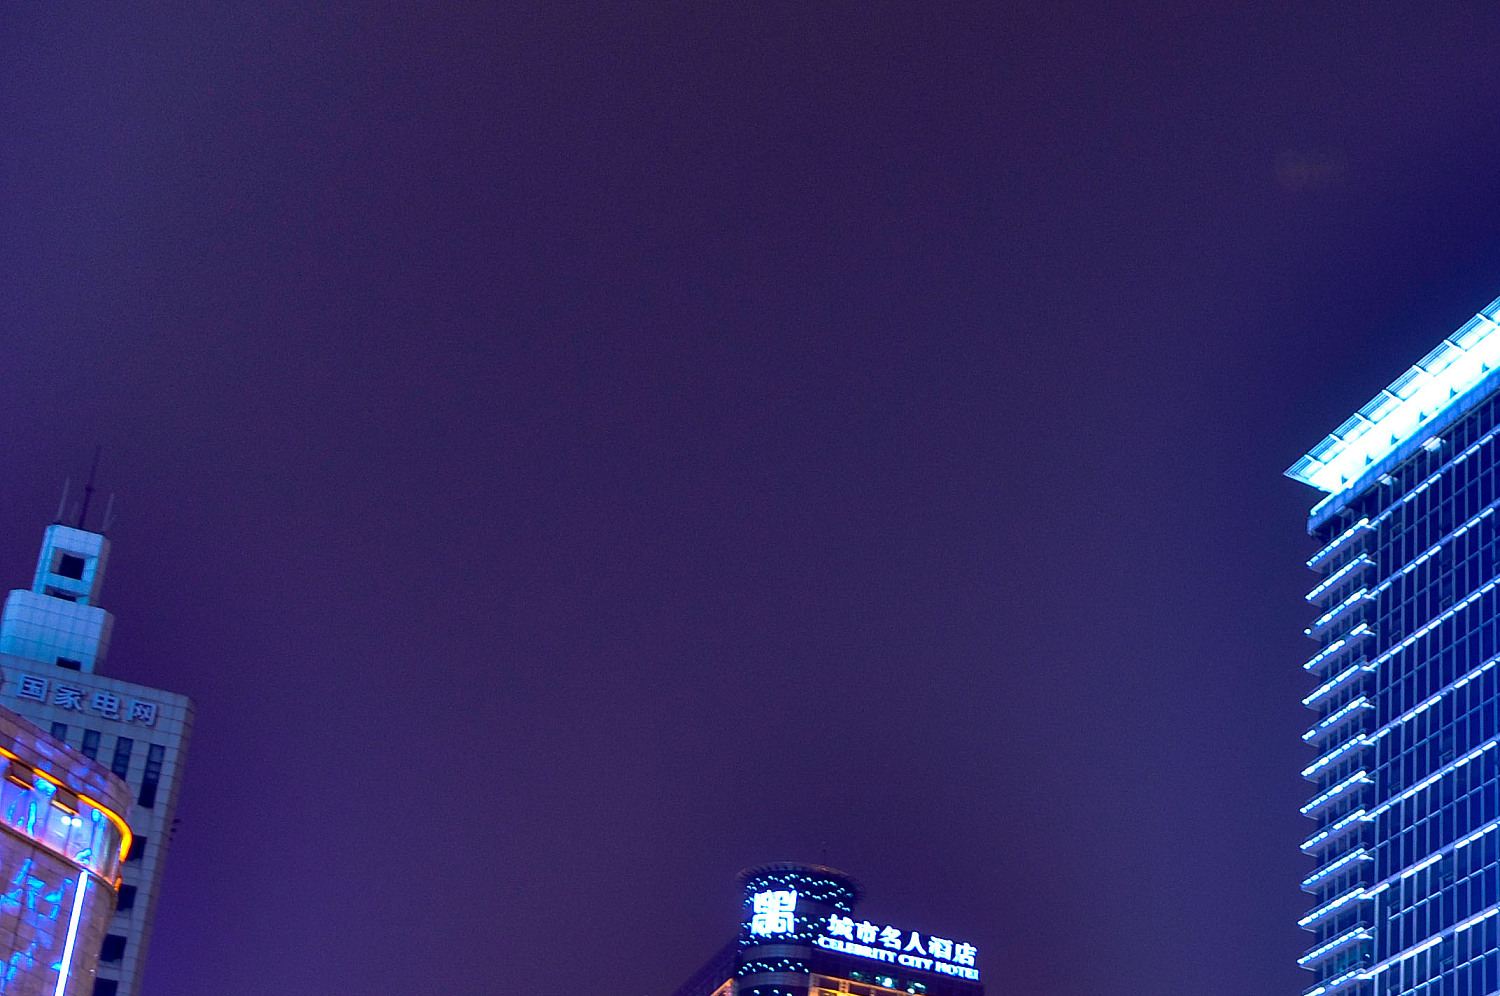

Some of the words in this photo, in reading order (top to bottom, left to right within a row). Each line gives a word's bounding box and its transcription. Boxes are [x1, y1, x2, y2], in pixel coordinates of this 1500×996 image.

[16, 673, 158, 726] 国家电网
[827, 914, 977, 966] 城市名人酒店
[898, 954, 933, 970] CITY
[935, 961, 979, 980] HOTEL
